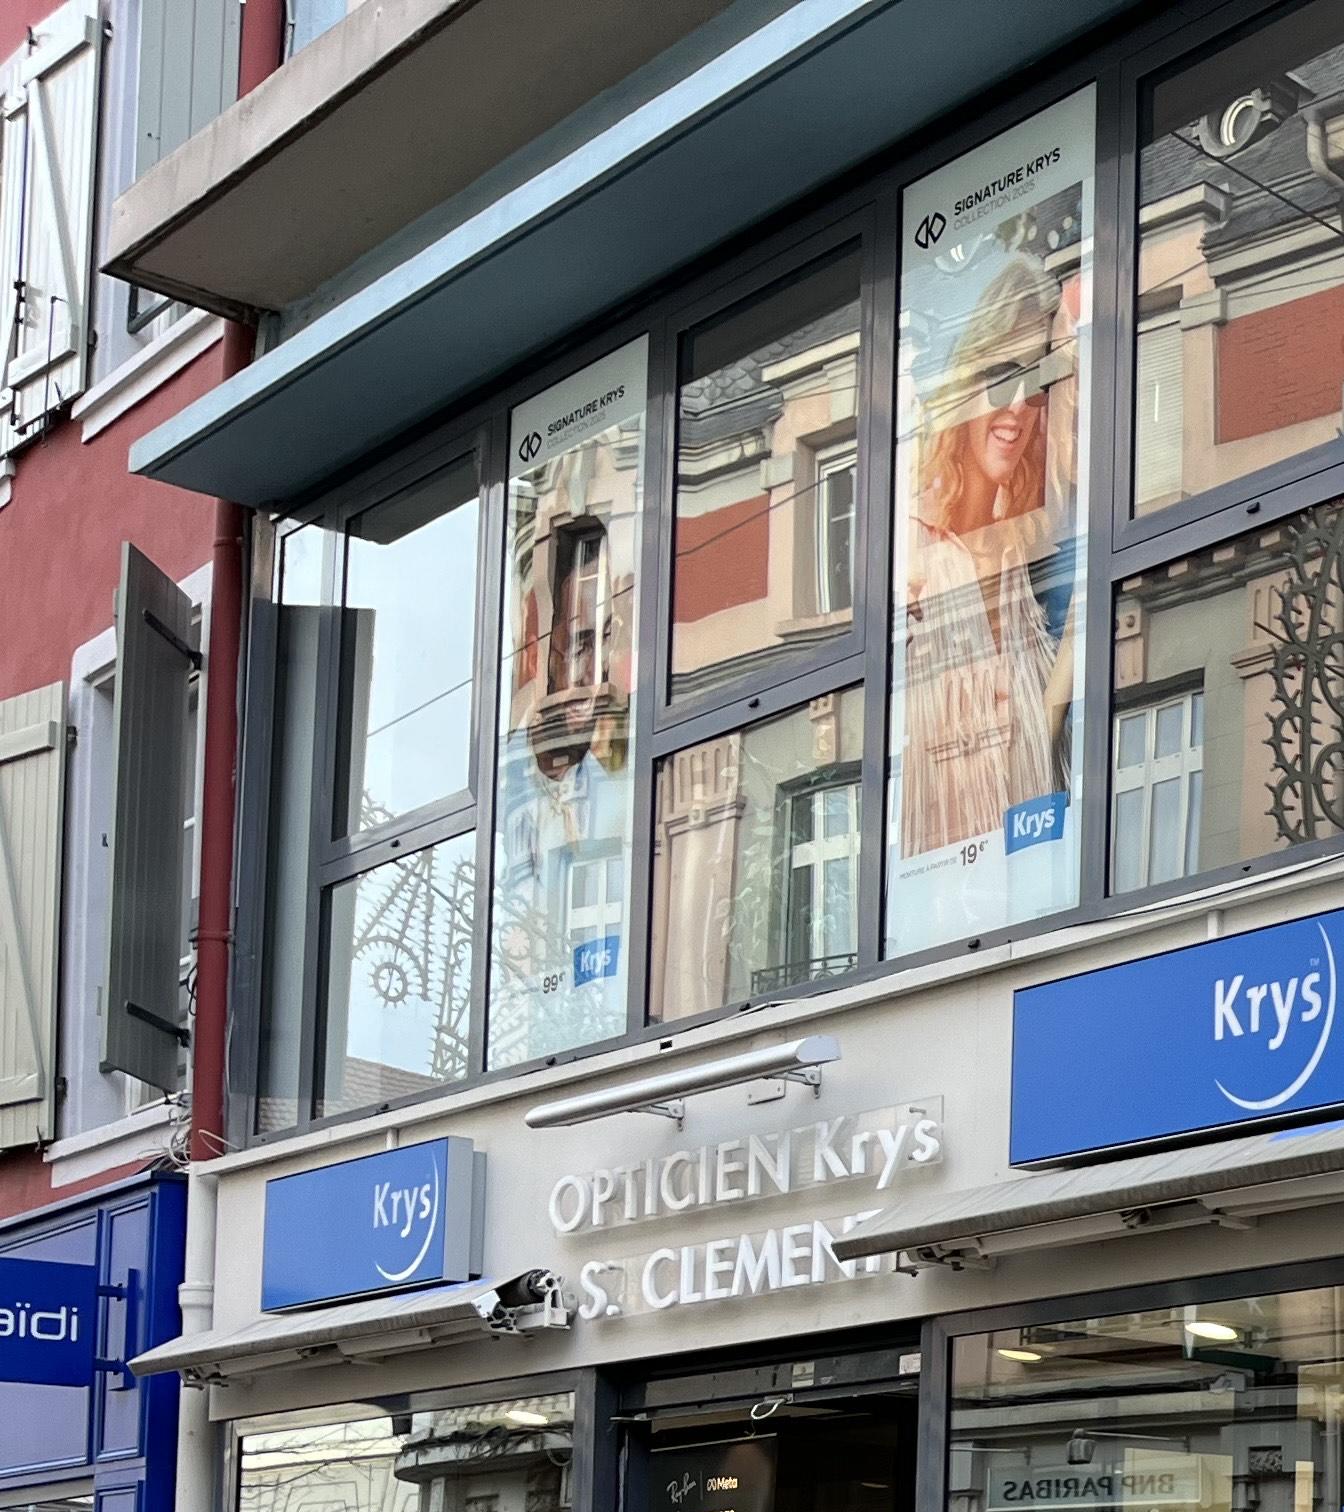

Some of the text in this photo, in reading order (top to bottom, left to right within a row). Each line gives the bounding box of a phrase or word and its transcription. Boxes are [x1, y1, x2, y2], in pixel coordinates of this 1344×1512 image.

[953, 147, 1061, 216] SIGNATURE KRYS
[953, 196, 1011, 231] COLLECTION
[547, 384, 625, 437] SIGNATURE KRYS
[1013, 807, 1056, 839] Krys
[581, 948, 612, 977] Krys
[1214, 972, 1323, 1051] Krys
[549, 1115, 941, 1233] OPTICIEN Krys
[373, 1182, 431, 1239] Krys
